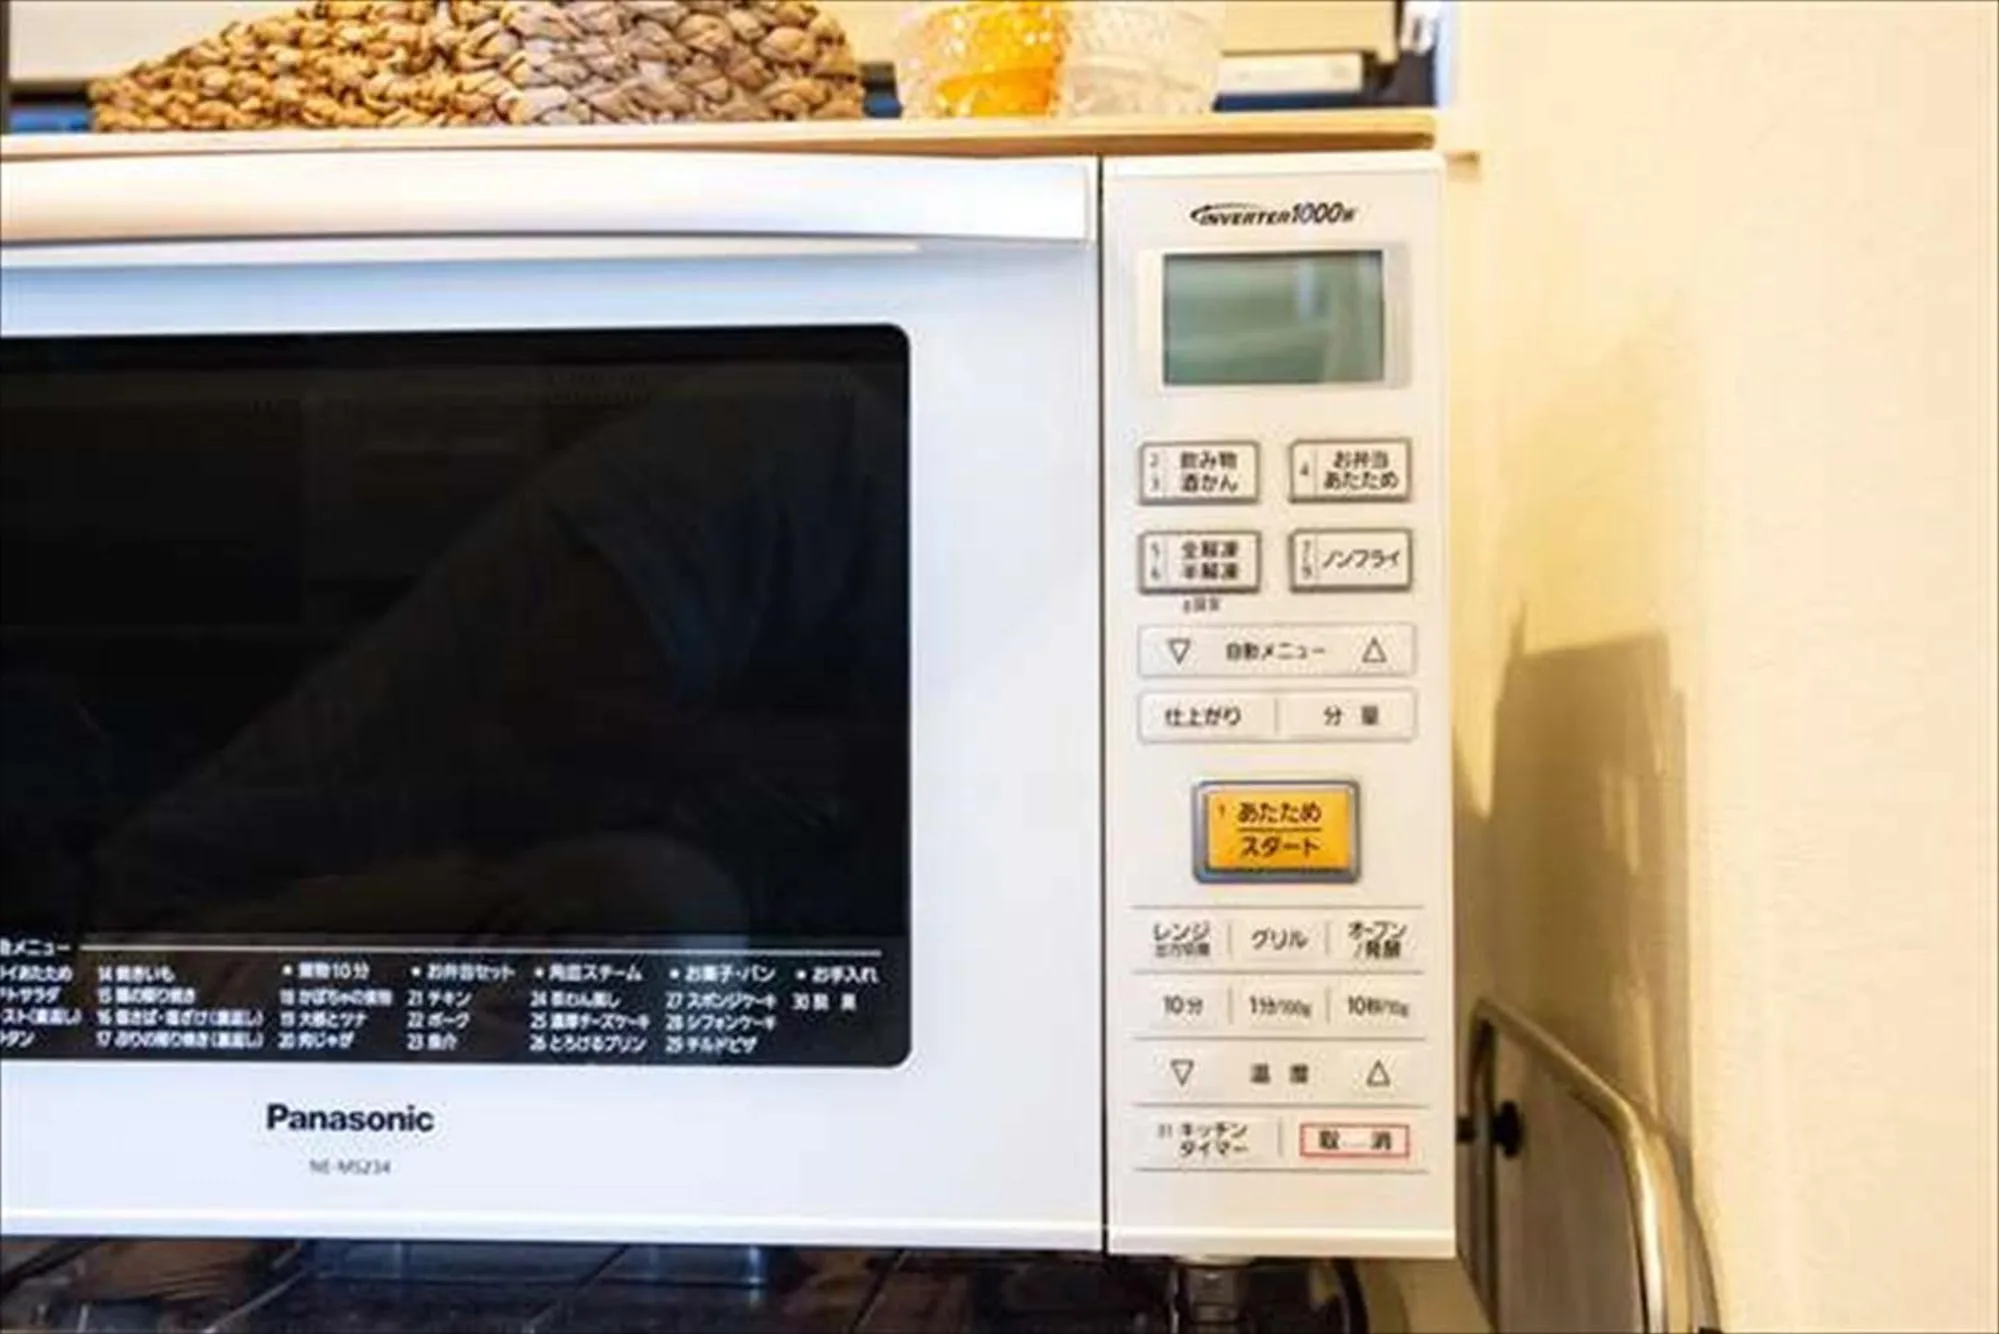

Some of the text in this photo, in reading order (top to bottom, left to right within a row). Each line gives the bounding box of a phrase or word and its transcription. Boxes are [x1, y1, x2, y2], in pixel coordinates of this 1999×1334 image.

[1180, 451, 1237, 470] 飲み物
[1333, 451, 1389, 470] お弁当
[1181, 473, 1238, 493] 酒かん
[1324, 471, 1399, 490] あたため
[1182, 541, 1238, 559] 全解凍
[1322, 549, 1400, 569] ノンフライ
[1226, 642, 1325, 661] 自動メニュー
[1165, 706, 1241, 727] 仕上がり
[1237, 802, 1321, 824] あたため
[1240, 836, 1320, 858] スタート
[1153, 921, 1210, 942] レンジ
[1252, 928, 1308, 950] グリル
[1164, 995, 1203, 1015] 10分
[267, 1103, 434, 1132] Panasonic
[1181, 1122, 1247, 1141] キッチン
[1180, 1140, 1248, 1158] タイマー
